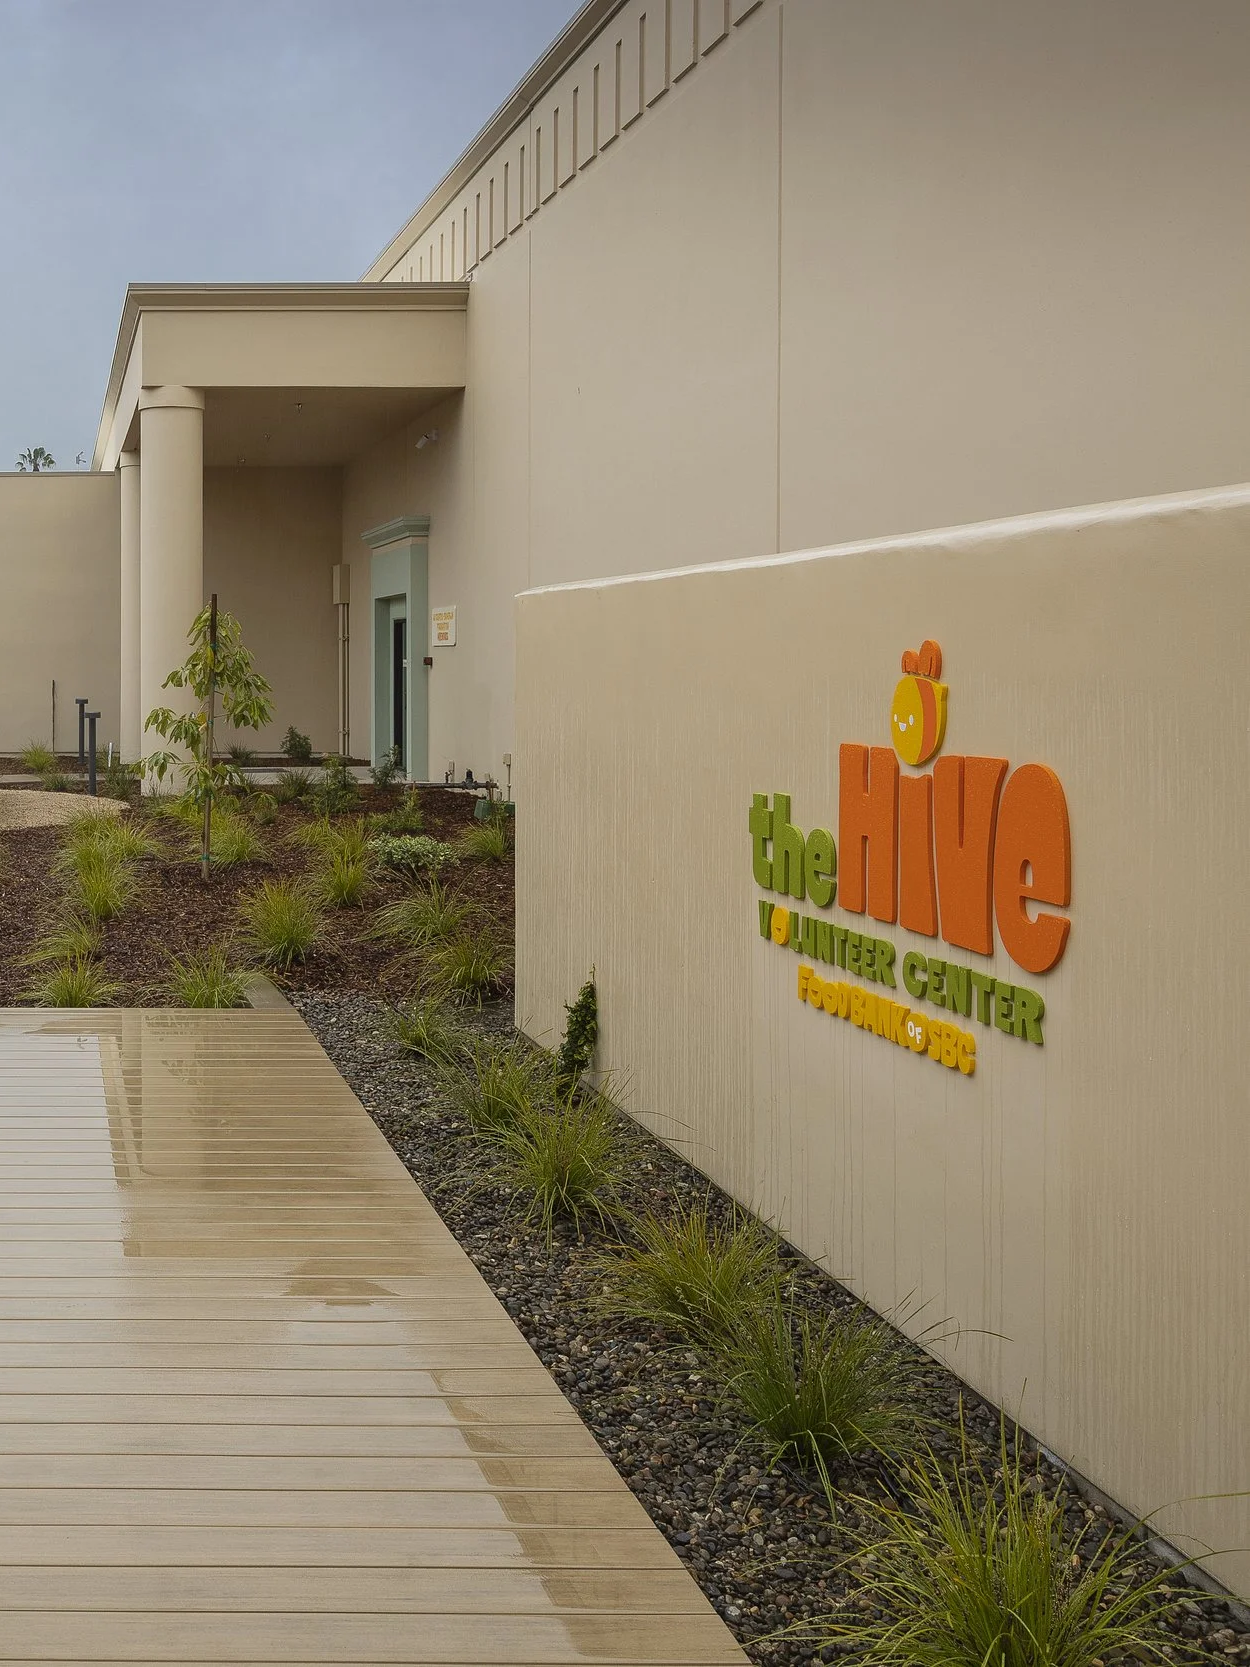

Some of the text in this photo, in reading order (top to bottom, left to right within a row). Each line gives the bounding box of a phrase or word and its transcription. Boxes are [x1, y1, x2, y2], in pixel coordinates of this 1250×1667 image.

[749, 793, 837, 907] the
[758, 899, 1044, 1044] VOLUNTEER CENTER
[927, 1018, 976, 1075] SBC
